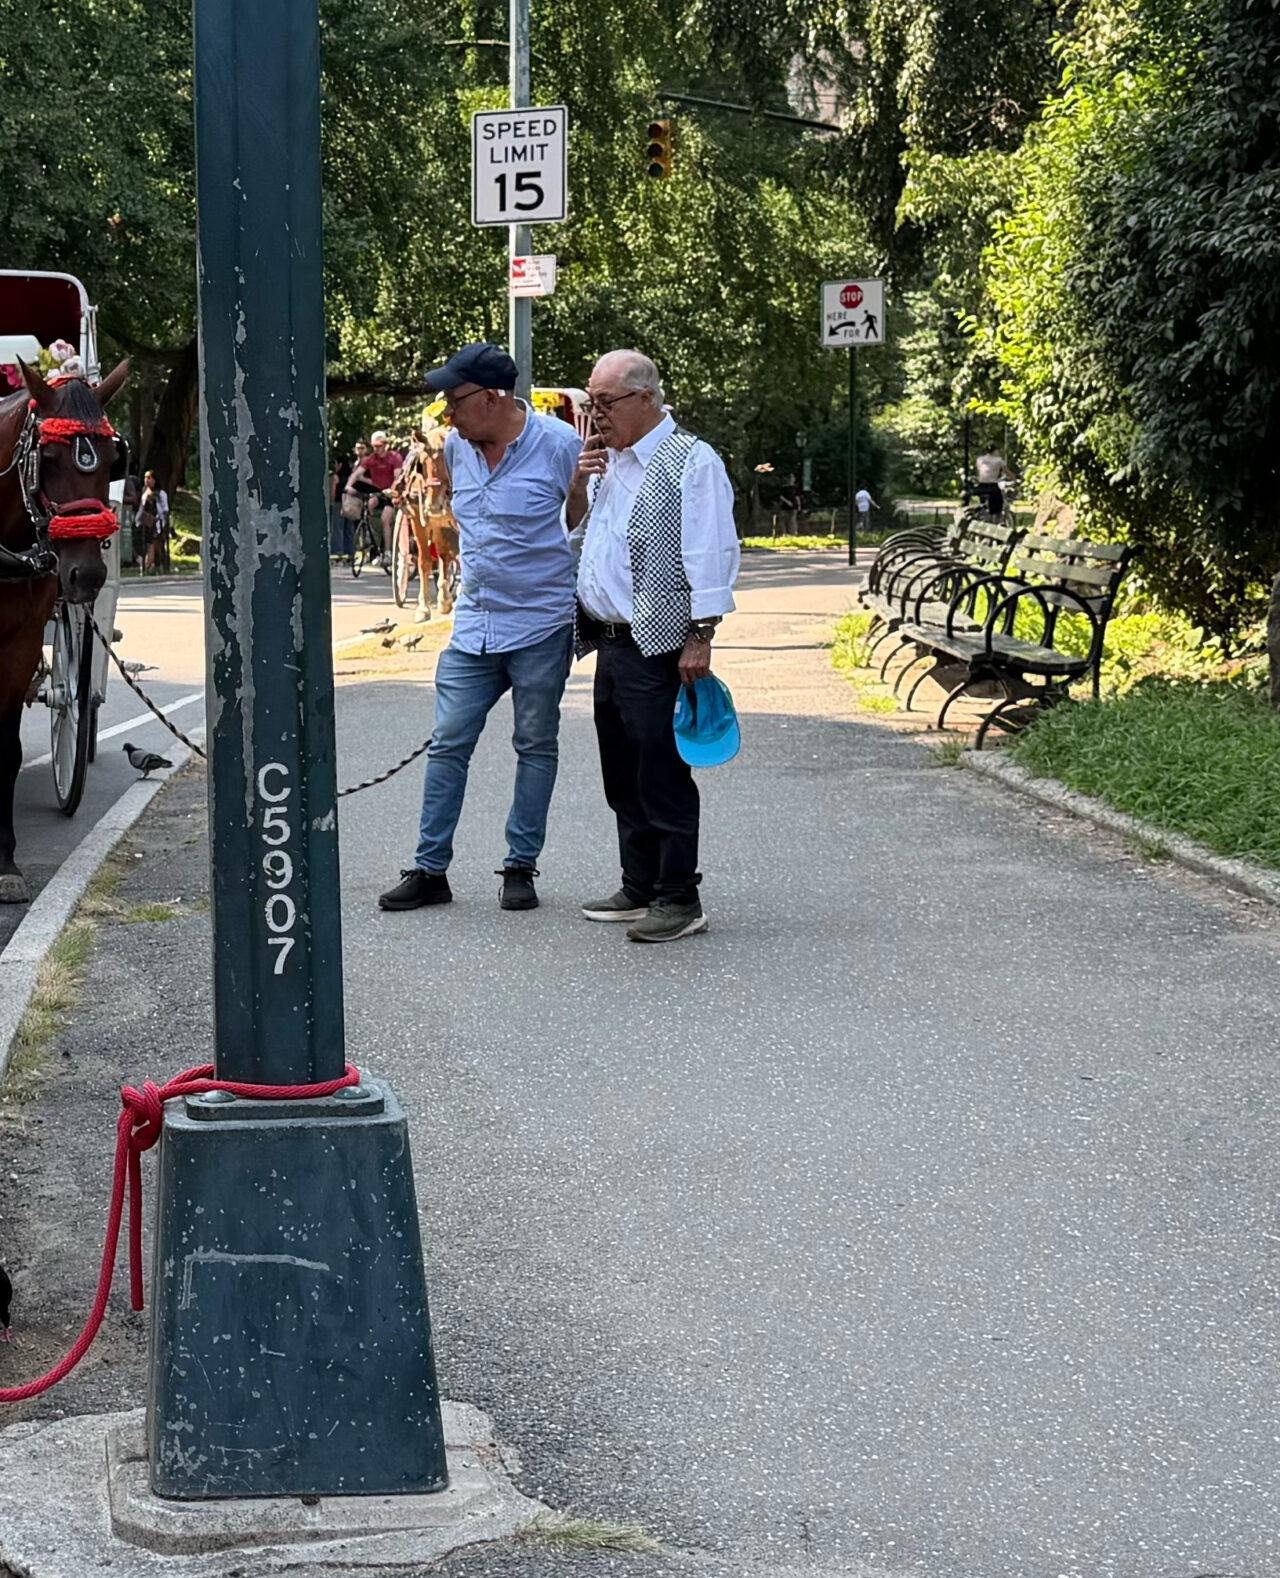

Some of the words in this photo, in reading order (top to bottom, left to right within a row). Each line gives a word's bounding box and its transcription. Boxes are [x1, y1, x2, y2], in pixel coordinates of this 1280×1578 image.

[483, 119, 557, 140] SPEED
[490, 143, 549, 163] LIMIT
[494, 171, 545, 212] 15
[840, 291, 863, 303] STOP
[826, 311, 848, 321] HERE
[844, 328, 860, 338] FOR
[258, 762, 297, 975] C5907
